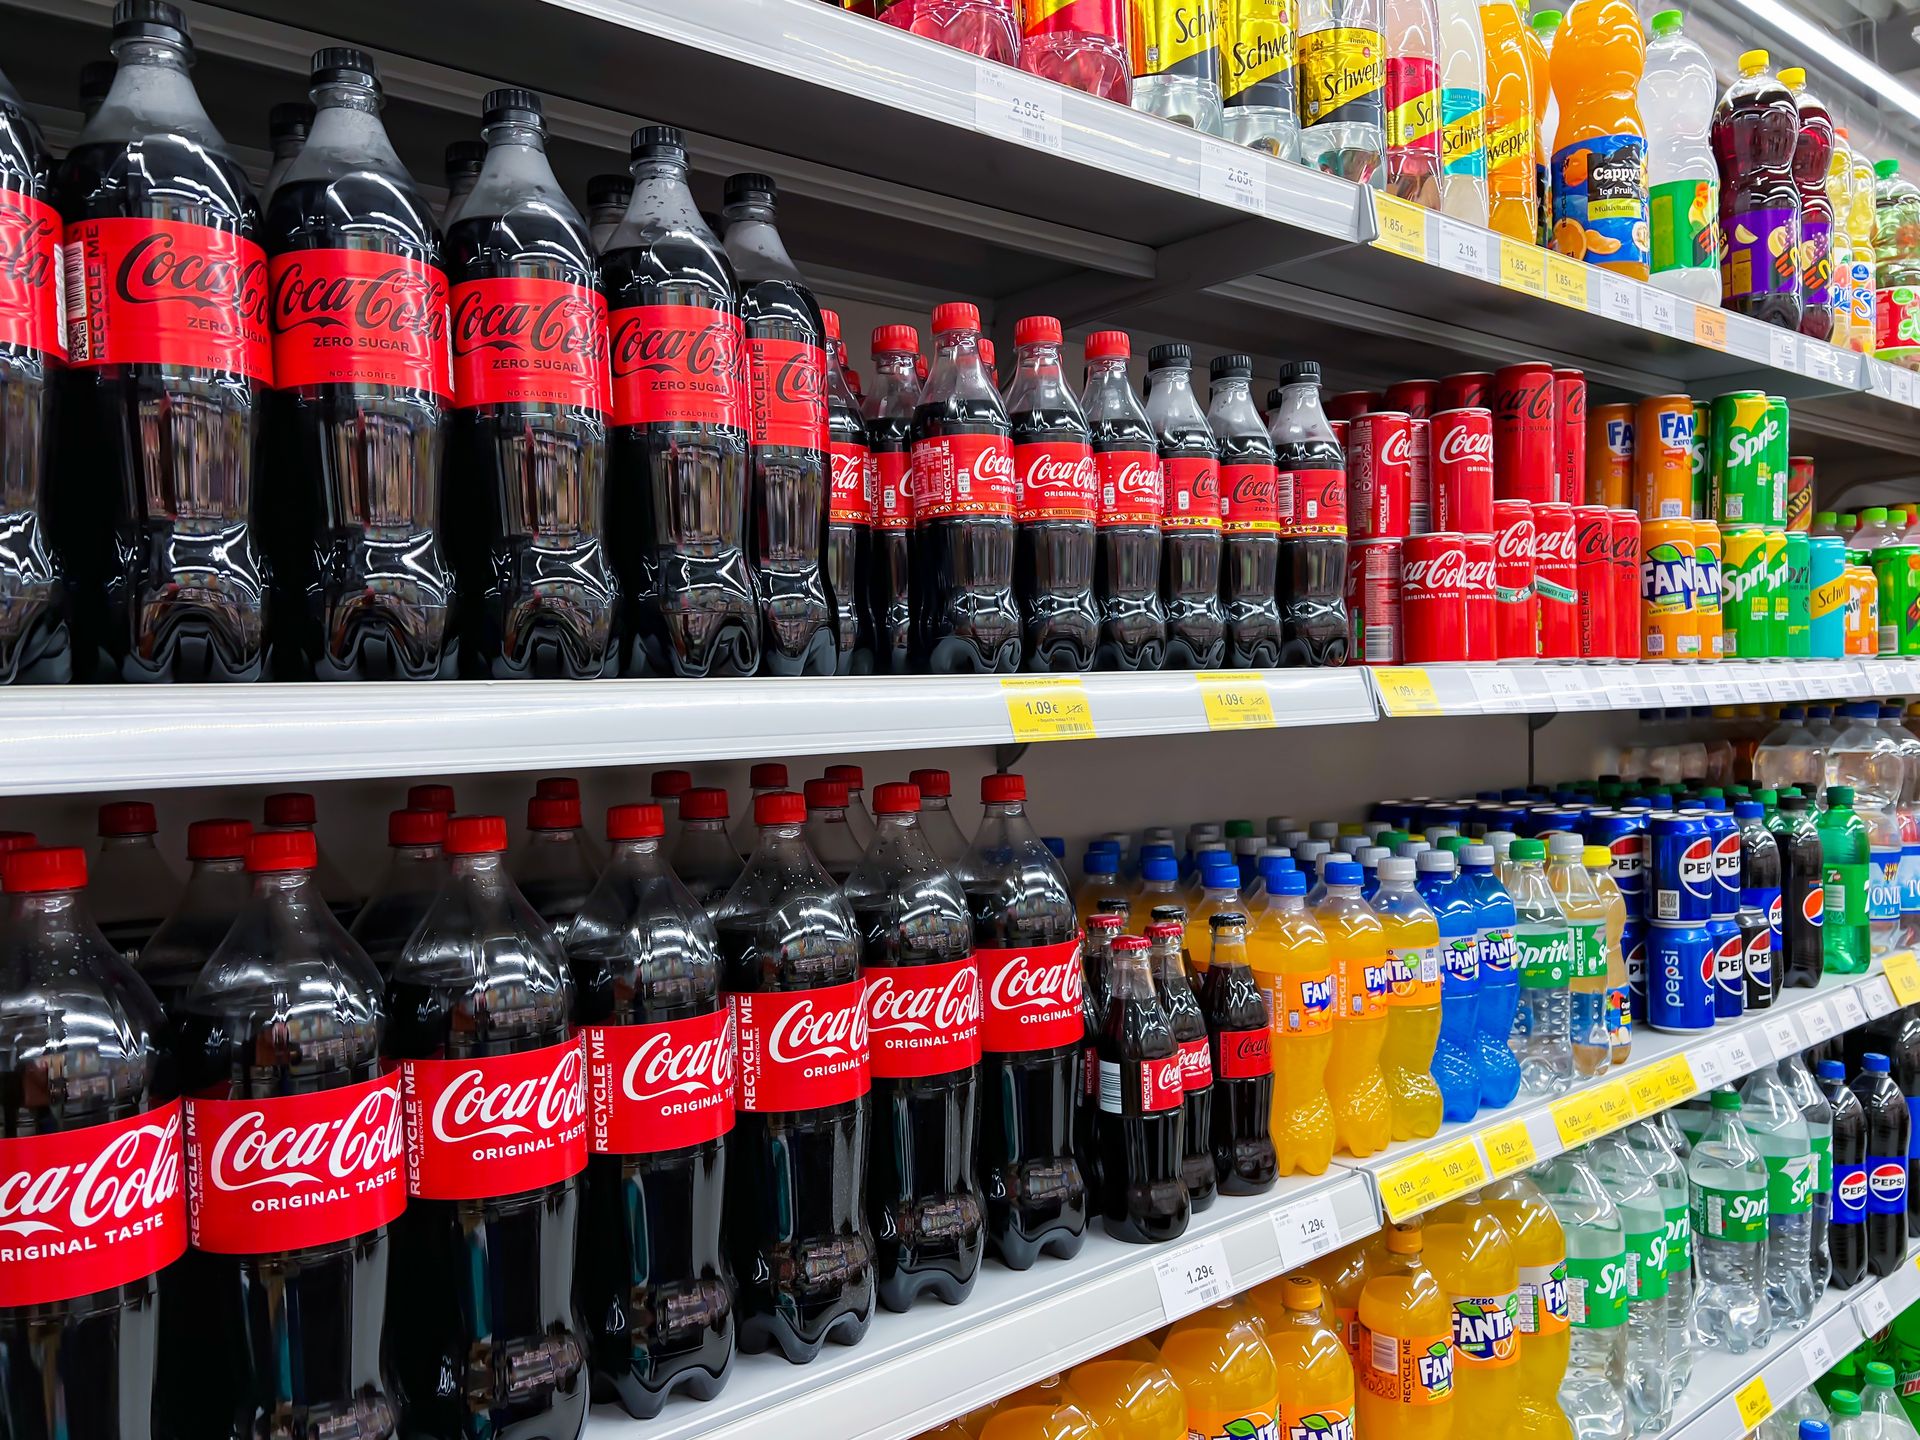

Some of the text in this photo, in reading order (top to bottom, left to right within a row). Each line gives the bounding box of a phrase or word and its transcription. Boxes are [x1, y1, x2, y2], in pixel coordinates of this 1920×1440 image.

[1593, 167, 1639, 182] Cappy
[1600, 186, 1634, 196] Ice Fruit
[1383, 216, 1404, 234] 1.85€
[86, 224, 100, 263] ME
[1459, 243, 1477, 259] 2.19€
[1510, 257, 1527, 272] 1.85€
[270, 263, 444, 341] Coca-Cola
[89, 265, 106, 359] RECYCLE
[187, 316, 229, 334] ZERO
[313, 336, 411, 353] ZERO SUGAR
[329, 370, 397, 380] NO CALORIES
[493, 359, 579, 374] ZERO SUGAR
[507, 389, 568, 399] NO CALORIES
[651, 380, 727, 394] ZERO SUGAR
[752, 343, 768, 441] RECYCLE ME
[665, 409, 719, 419] NO CALORIES
[1673, 439, 1690, 447] zero
[1568, 449, 1574, 466] ME
[941, 439, 952, 502] RECYCLE ME
[1165, 462, 1171, 479] ME
[870, 457, 879, 518] RECYCLE ME
[1380, 484, 1387, 502] ME
[1440, 483, 1445, 500] ME
[1582, 590, 1591, 654] RECYCLE ME
[1217, 693, 1244, 706] 1.09€
[1393, 685, 1415, 696] 1.09€
[1025, 701, 1059, 715] 1.09€
[1576, 927, 1583, 940] ME
[1516, 940, 1569, 969] Sprite
[1661, 950, 1684, 1008] pepsi
[1339, 960, 1347, 1017] RECYCLE ME
[1275, 975, 1284, 1033] RECYCLE ME
[1020, 1010, 1072, 1025] ORIGINAL
[884, 1026, 977, 1049] ORIGINAL TASTE
[740, 996, 756, 1110] RECYCLE ME
[803, 1058, 860, 1078] ORIGINAL
[591, 1028, 609, 1151] RECYCLE ME
[1142, 1063, 1151, 1110] RECYCLE ME
[661, 1093, 723, 1117] ORIGINAL
[1600, 1100, 1616, 1113] 1.09€
[403, 1062, 421, 1196] RECYCLE ME
[1564, 1116, 1582, 1129] 1.09€
[472, 1121, 586, 1161] ORIGINAL TASTE
[1495, 1143, 1515, 1157] 1.09€
[185, 1101, 201, 1248] RECYCLE ME
[1443, 1162, 1463, 1178] 1.09€
[252, 1167, 397, 1213] ORIGINAL TASTE
[1394, 1181, 1415, 1198] 1.09€
[1872, 1177, 1905, 1187] PEPSI
[104, 1213, 164, 1243] TASTE
[1301, 1218, 1325, 1236] 1.29€
[1187, 1265, 1215, 1285] 1.29€
[1470, 1297, 1495, 1306] ZERO
[1403, 1339, 1412, 1404] RECYCLE ME
